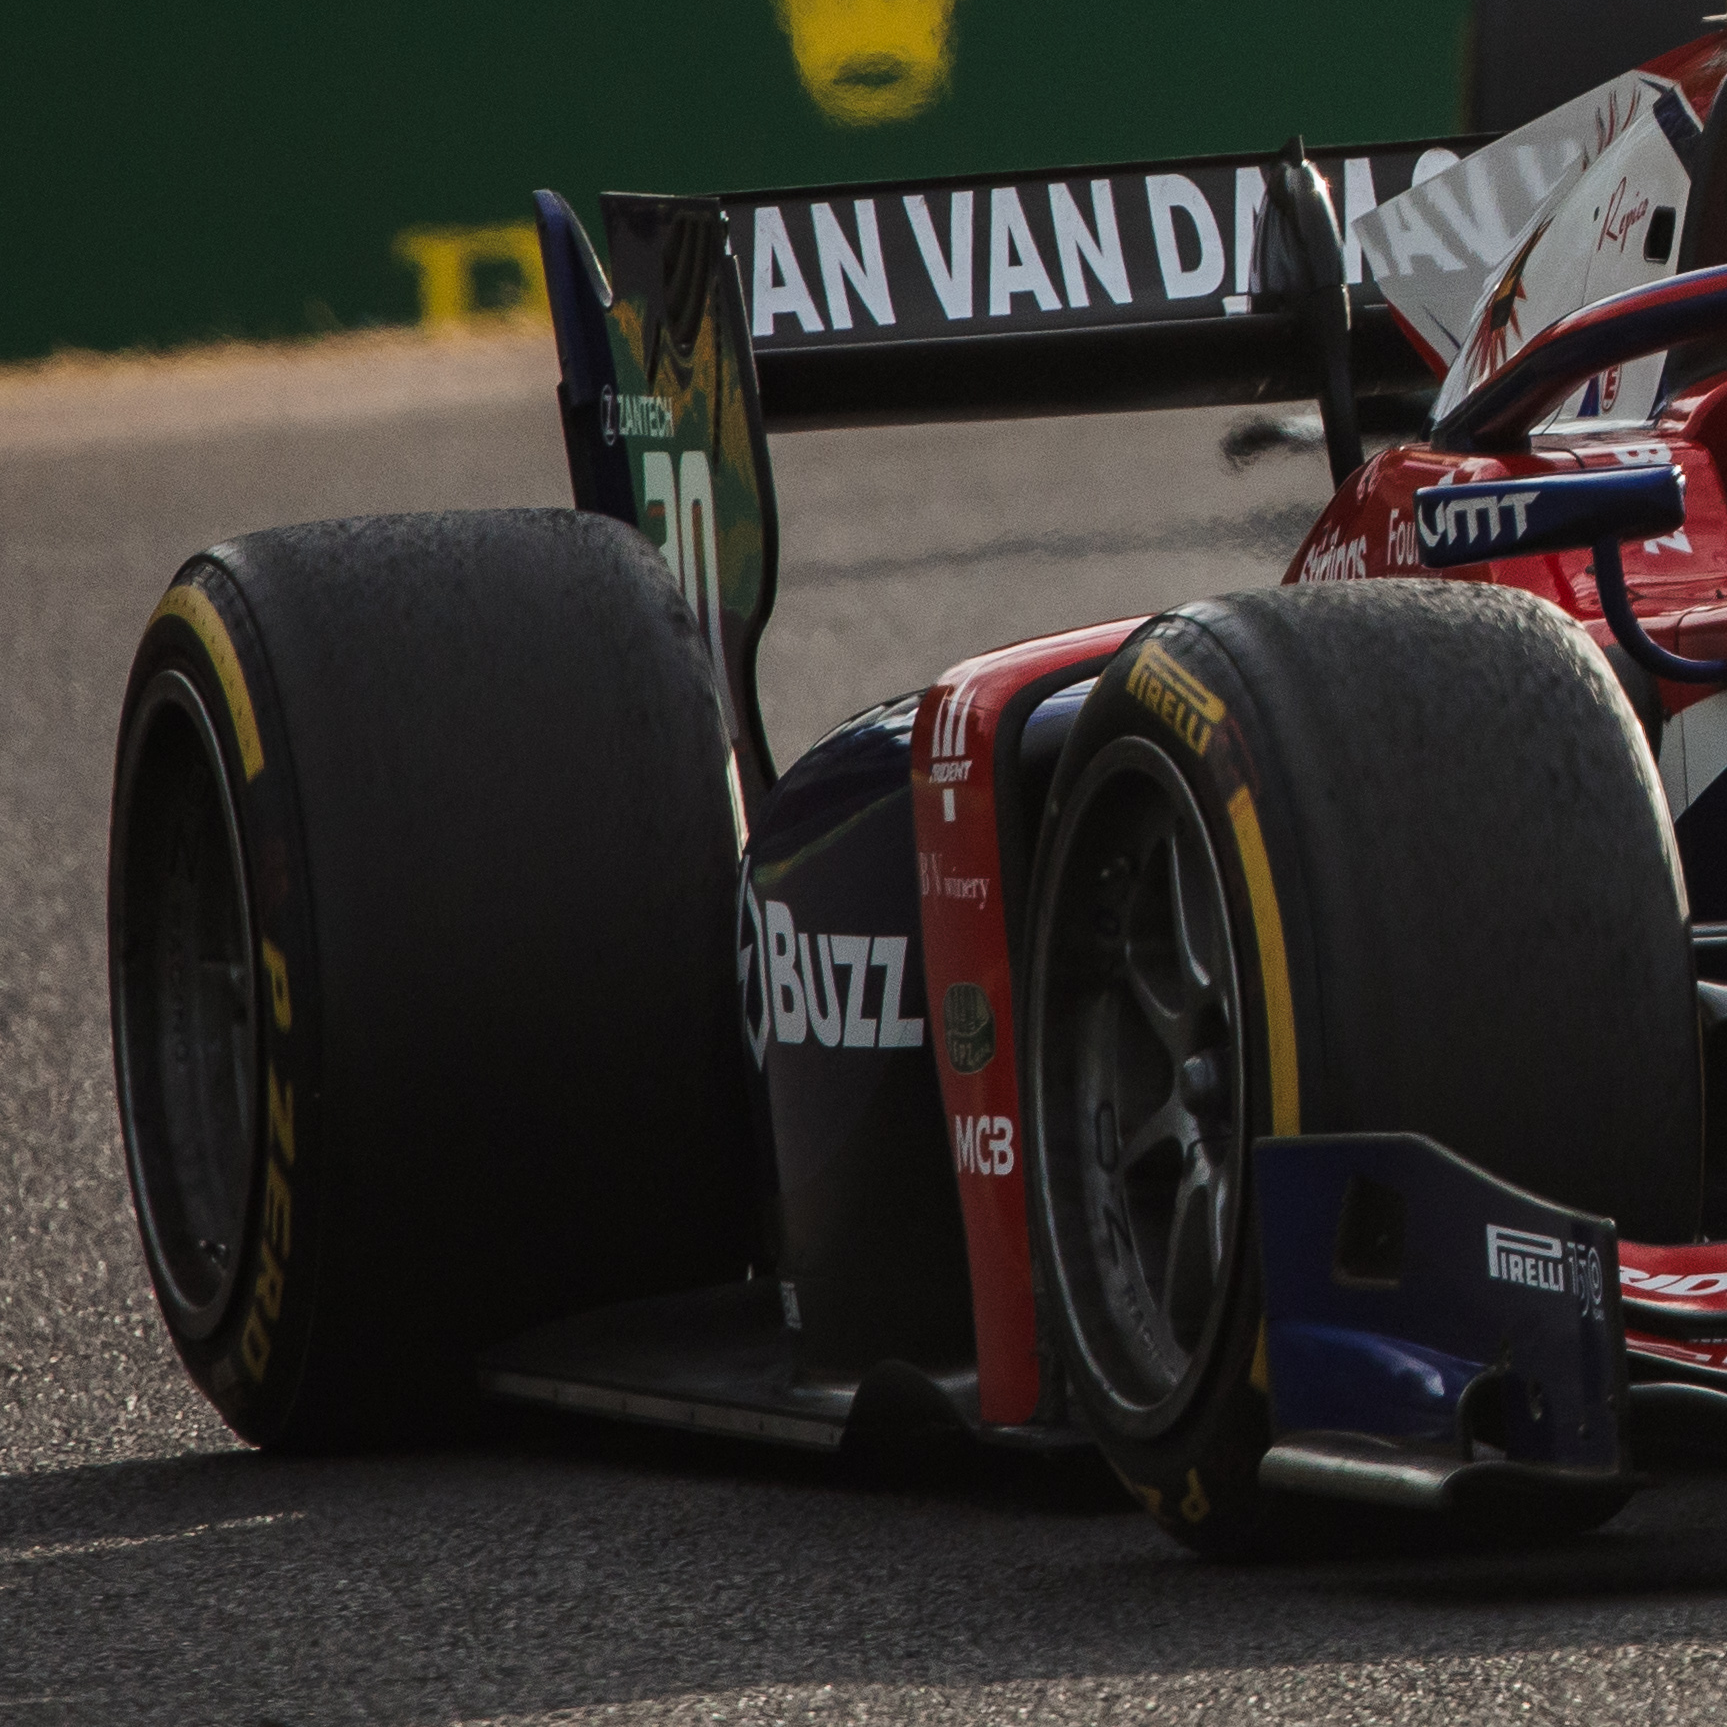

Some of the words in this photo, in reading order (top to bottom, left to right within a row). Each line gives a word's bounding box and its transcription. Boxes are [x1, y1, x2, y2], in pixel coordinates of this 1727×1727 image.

[903, 177, 1134, 321] VAN
[617, 393, 675, 438] ZANTECH
[1126, 640, 1227, 755] PIRELLI
[262, 938, 293, 1033] P
[765, 900, 925, 1048] BUZZ
[1486, 1223, 1565, 1293] PIRELLI
